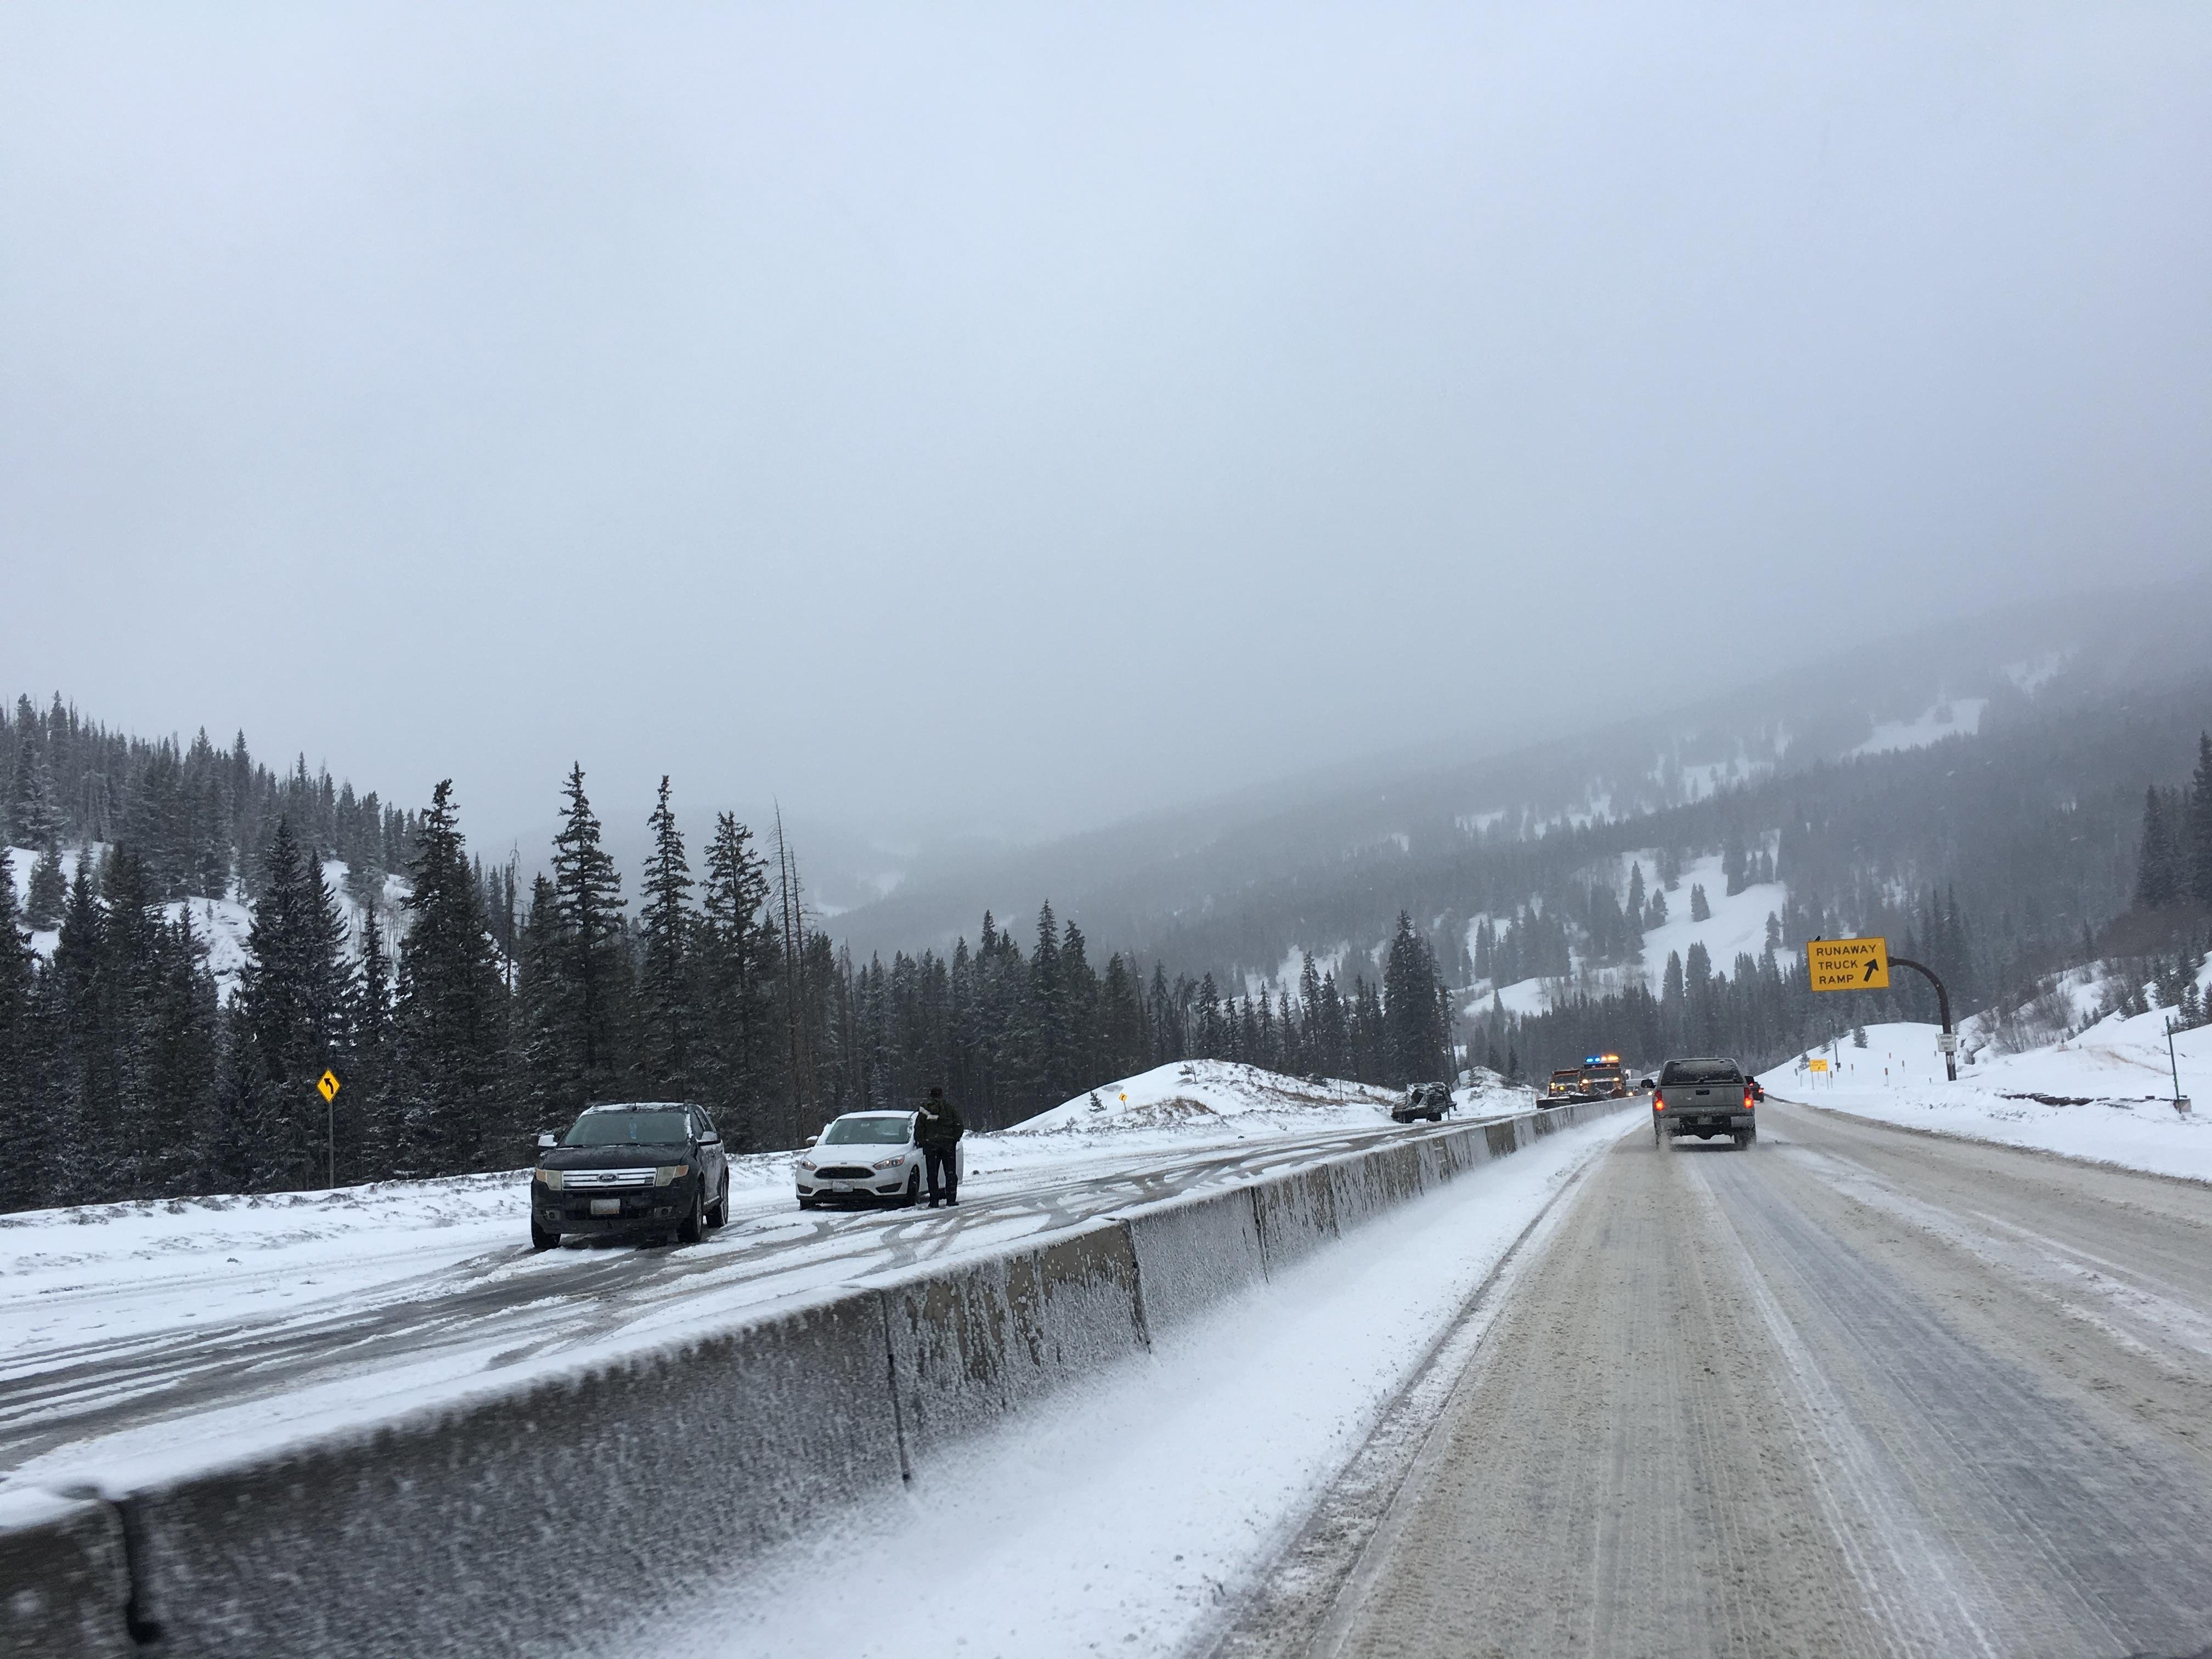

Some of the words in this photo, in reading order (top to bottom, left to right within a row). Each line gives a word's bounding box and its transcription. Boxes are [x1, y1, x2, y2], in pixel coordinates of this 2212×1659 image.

[1816, 944, 1876, 956] RUNAWAY
[1818, 960, 1858, 970] TRUCK
[1819, 974, 1854, 984] RAMP
